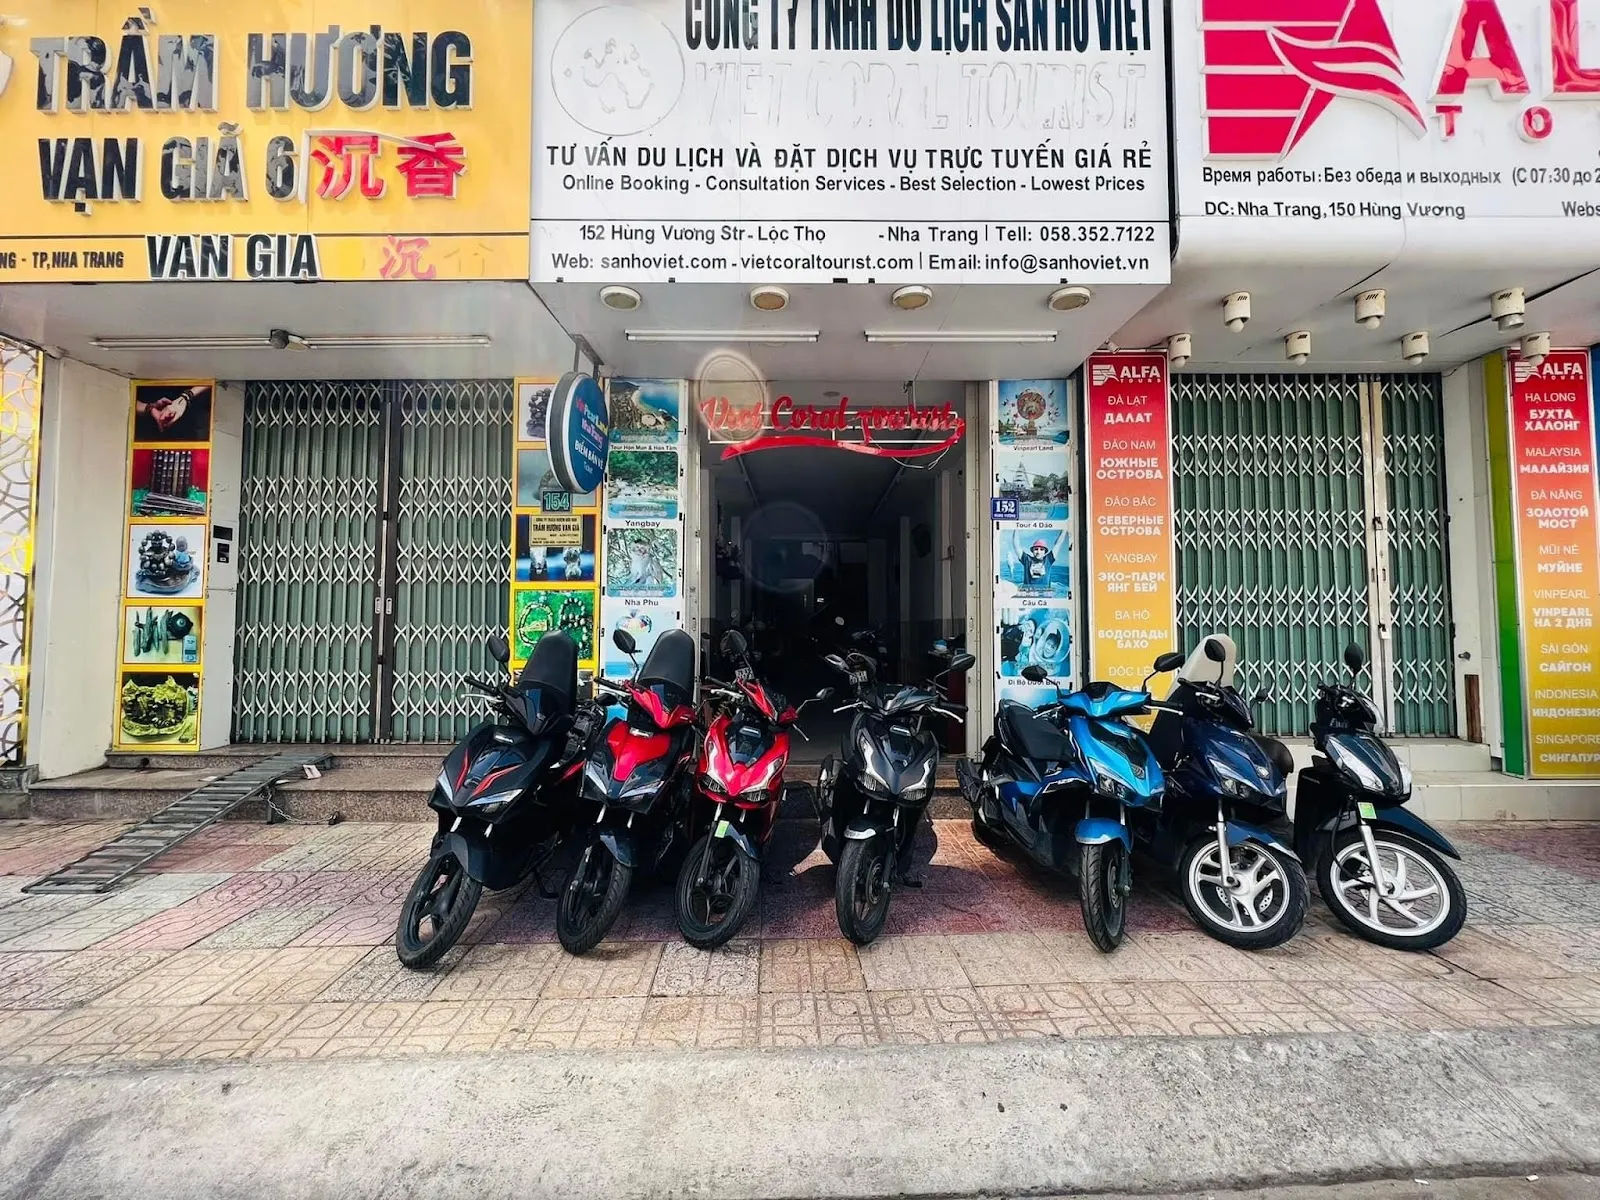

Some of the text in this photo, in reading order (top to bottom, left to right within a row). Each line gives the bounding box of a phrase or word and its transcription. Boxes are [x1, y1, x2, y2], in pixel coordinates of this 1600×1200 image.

[30, 8, 475, 113] TRẦM HƯƠNG
[547, 137, 1152, 173] TƯ VẤN DU LỊCH VÀ ĐẶT DỊCH VỤ TRỰC TUYẾN GIÁ RẺ
[38, 122, 300, 216] VẠN GIÃ 6
[310, 133, 468, 201] 沉香
[1202, 167, 1251, 186] Время
[1356, 167, 1402, 186] обеда
[1406, 171, 1416, 184] и
[1420, 171, 1502, 186] выходных
[1572, 171, 1592, 186] до
[563, 175, 1145, 194] Online Booking Consultation Services Best Selection Lowest Prices
[1360, 202, 1401, 220] Hùng
[1406, 202, 1466, 220] Vương
[579, 225, 605, 241] 152
[611, 225, 655, 244] Hùng
[661, 225, 716, 245] Vương
[758, 225, 789, 244] Lộc
[794, 225, 826, 244] Thọ
[928, 226, 978, 245] Trang
[995, 226, 1032, 242] Tell:
[1039, 226, 1155, 242] 058.352.7122
[83, 251, 124, 269] TRANG
[146, 234, 321, 280] VAN GIA
[551, 253, 594, 269] Web:
[600, 253, 727, 270] sanhoviet.com
[740, 254, 913, 270] vietcoraltourist.com
[1120, 366, 1161, 378] ALFA
[1542, 363, 1584, 376] ALFA
[1107, 394, 1148, 407] ĐÀ LẠT
[1544, 393, 1576, 402] LONG
[771, 396, 849, 431] Coral
[1104, 413, 1152, 425] ДАЛАТ
[1529, 409, 1573, 419] БУХТА
[1525, 421, 1580, 431] ХАЛОНГ
[1130, 440, 1156, 450] NAM
[1525, 447, 1582, 457] MALAYSIA
[1100, 458, 1158, 468] ЮЖНЫЕ
[1520, 461, 1590, 473] МАЛАЙЗИЯ
[1096, 469, 1163, 480] ОСТРОВА
[544, 493, 569, 510] 154
[995, 501, 1015, 513] 152
[1526, 505, 1589, 518] ЗОЛОТОЙ
[625, 520, 661, 528] Yangbay
[1097, 515, 1164, 526] СЕВЕРНЫЕ
[1538, 519, 1578, 529] МОСТ
[1100, 526, 1161, 536] ОСТРОВА
[1105, 553, 1158, 564] YANGBAY
[1537, 560, 1583, 573] МУЙНЕ
[1098, 572, 1166, 582] ЭКО-ПАРК
[1107, 581, 1158, 593] ЯНГ БЕЙ
[1534, 589, 1590, 599] VINPEARL
[1114, 611, 1130, 621] BA
[1532, 607, 1593, 617] VINPEARL
[1534, 618, 1593, 629] НА 2 ДНЯ
[1098, 629, 1168, 640] ВОДОПАДЫ
[1117, 640, 1149, 649] БАХО
[1540, 660, 1591, 673] САЙГОН
[1535, 689, 1598, 699] INDONESIA
